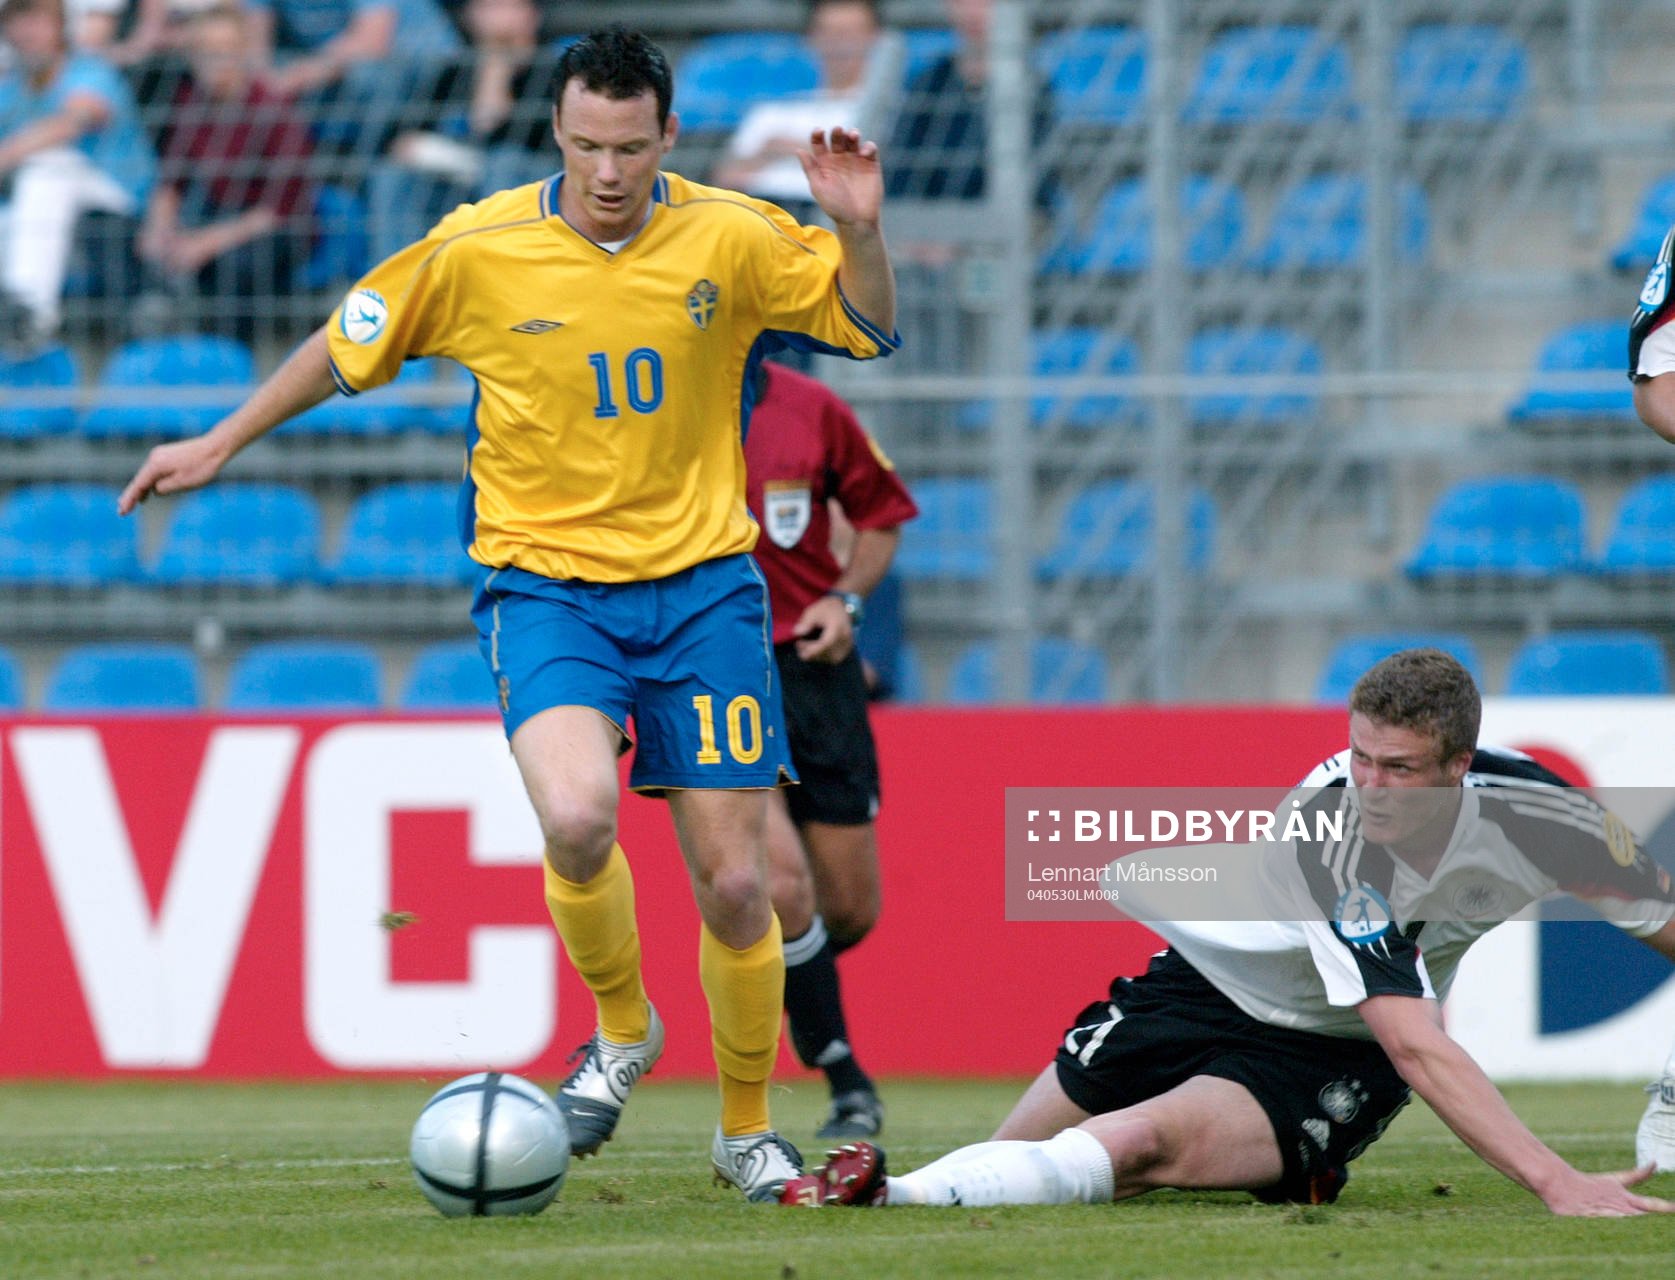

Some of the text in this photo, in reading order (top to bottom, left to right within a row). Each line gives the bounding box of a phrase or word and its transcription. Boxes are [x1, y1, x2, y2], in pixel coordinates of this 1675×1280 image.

[588, 347, 664, 418] 10
[692, 694, 763, 765] 10
[0, 721, 556, 1070] VC
